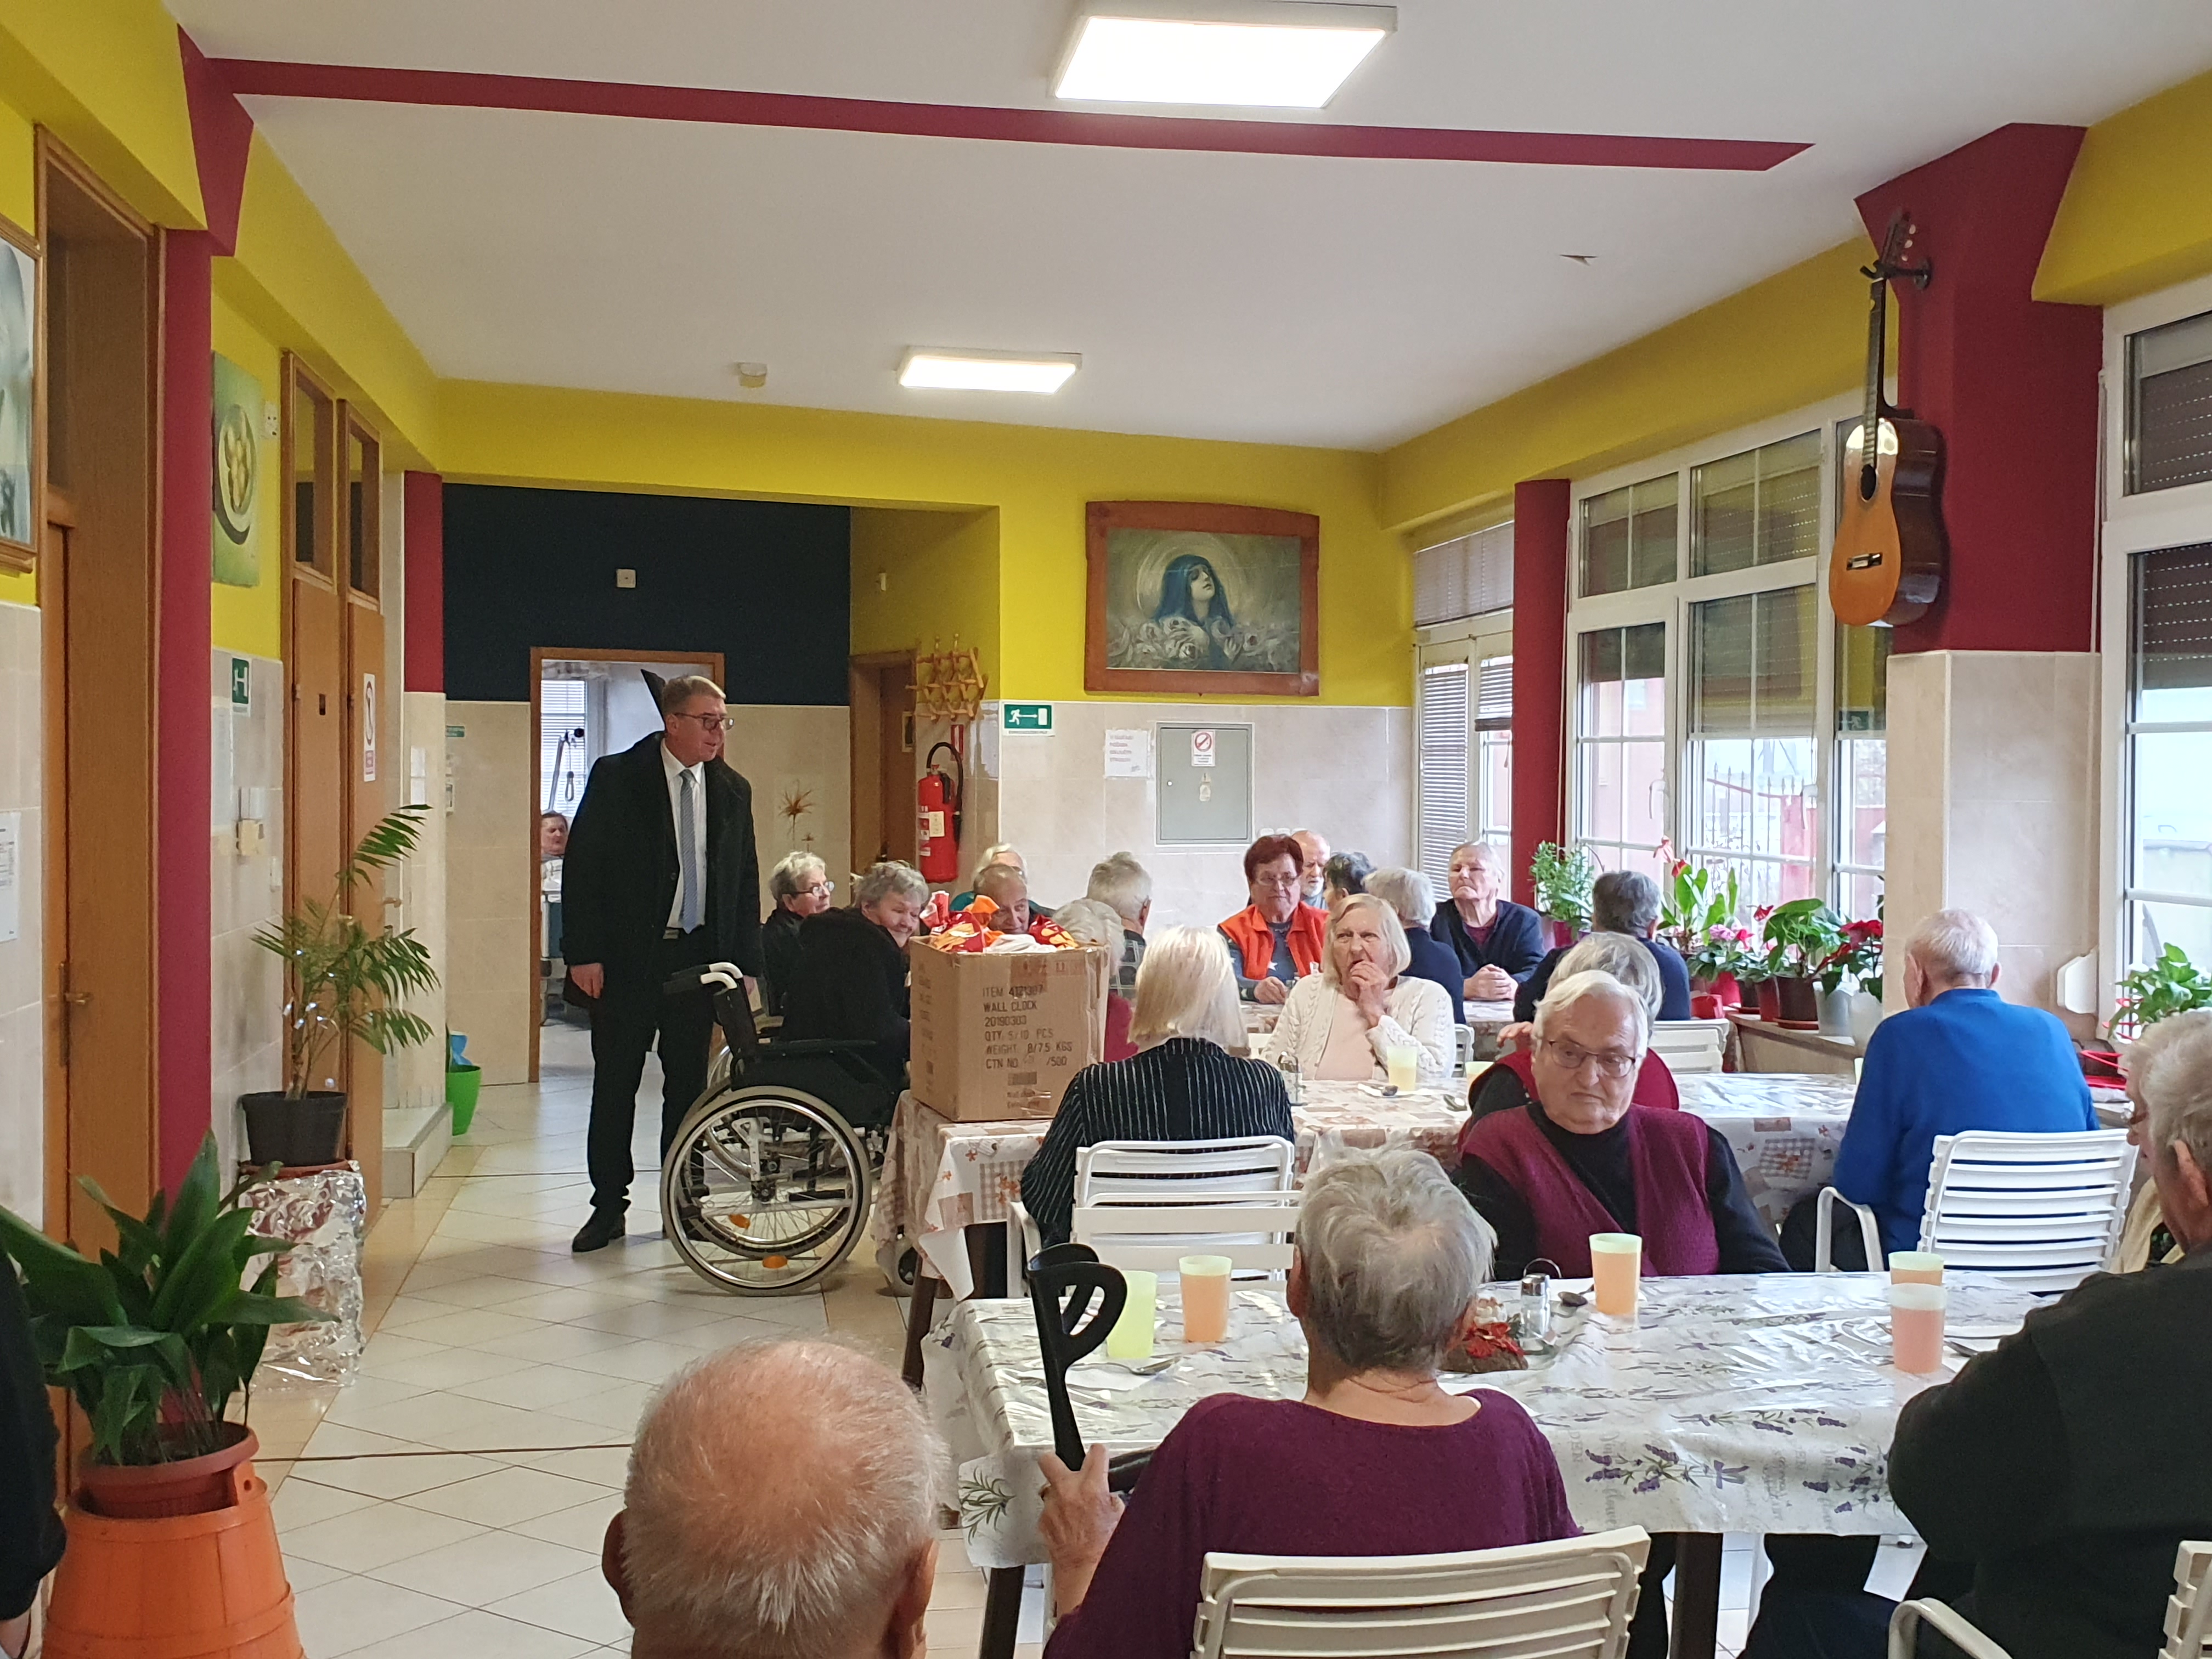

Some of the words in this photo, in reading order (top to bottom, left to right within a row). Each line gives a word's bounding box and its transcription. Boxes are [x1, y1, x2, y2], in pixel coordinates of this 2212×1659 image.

[983, 987, 1003, 997] ITEM
[984, 1002, 1008, 1012] WALL
[1011, 1000, 1037, 1012] CLOCK
[1036, 1028, 1053, 1039] PCS
[1056, 1041, 1073, 1052] KGS
[985, 1058, 1003, 1069] CTN
